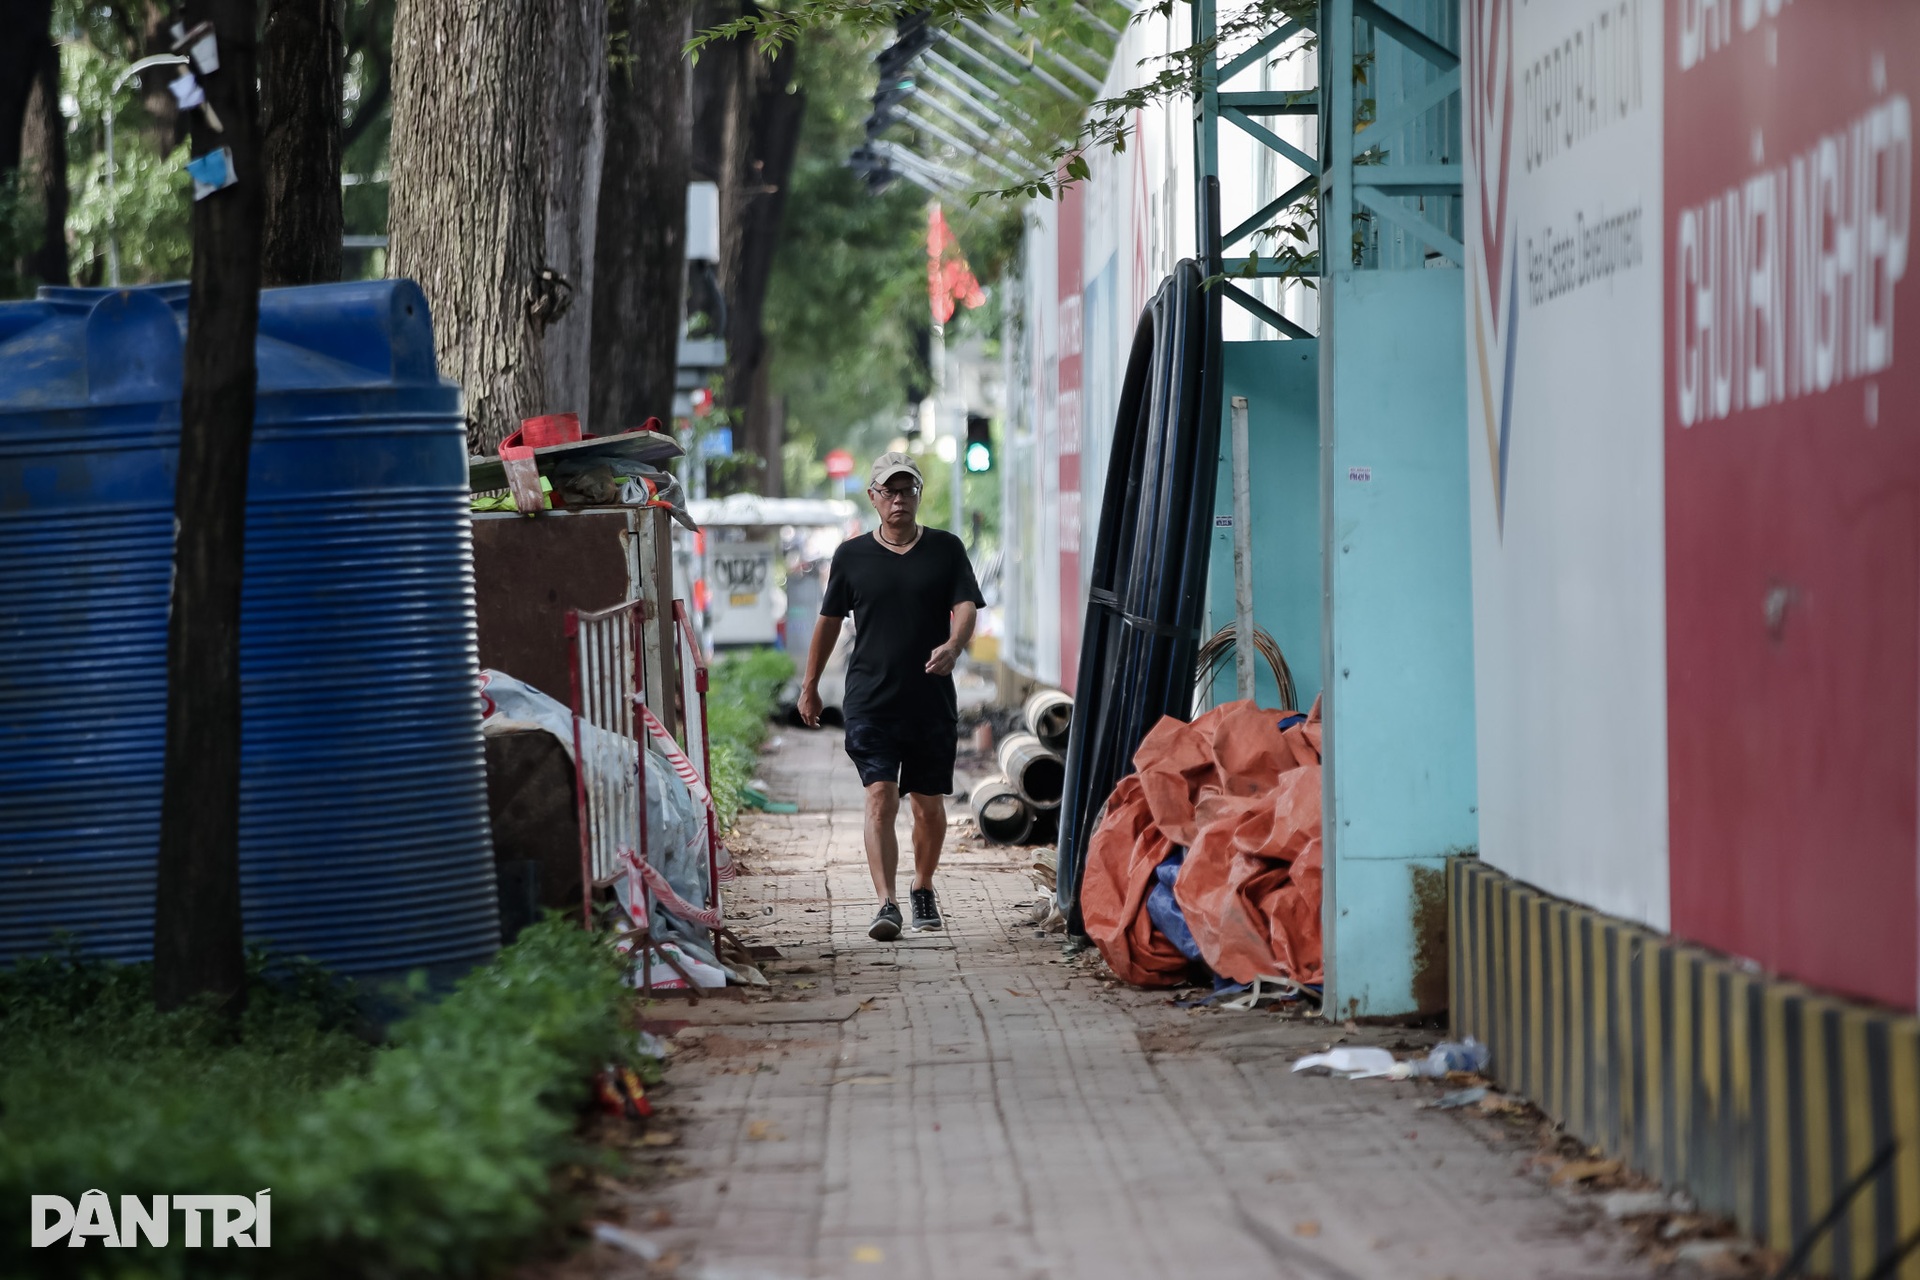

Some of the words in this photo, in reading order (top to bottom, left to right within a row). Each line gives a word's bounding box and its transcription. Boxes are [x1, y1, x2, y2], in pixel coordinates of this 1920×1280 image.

[1524, 0, 1644, 174] CORPORATION
[1527, 228, 1546, 308] Real
[1547, 226, 1575, 300] Estate
[1578, 202, 1643, 296] Development
[1678, 128, 1788, 428] CHUYÊN
[1788, 52, 1913, 428] NGHIỆP
